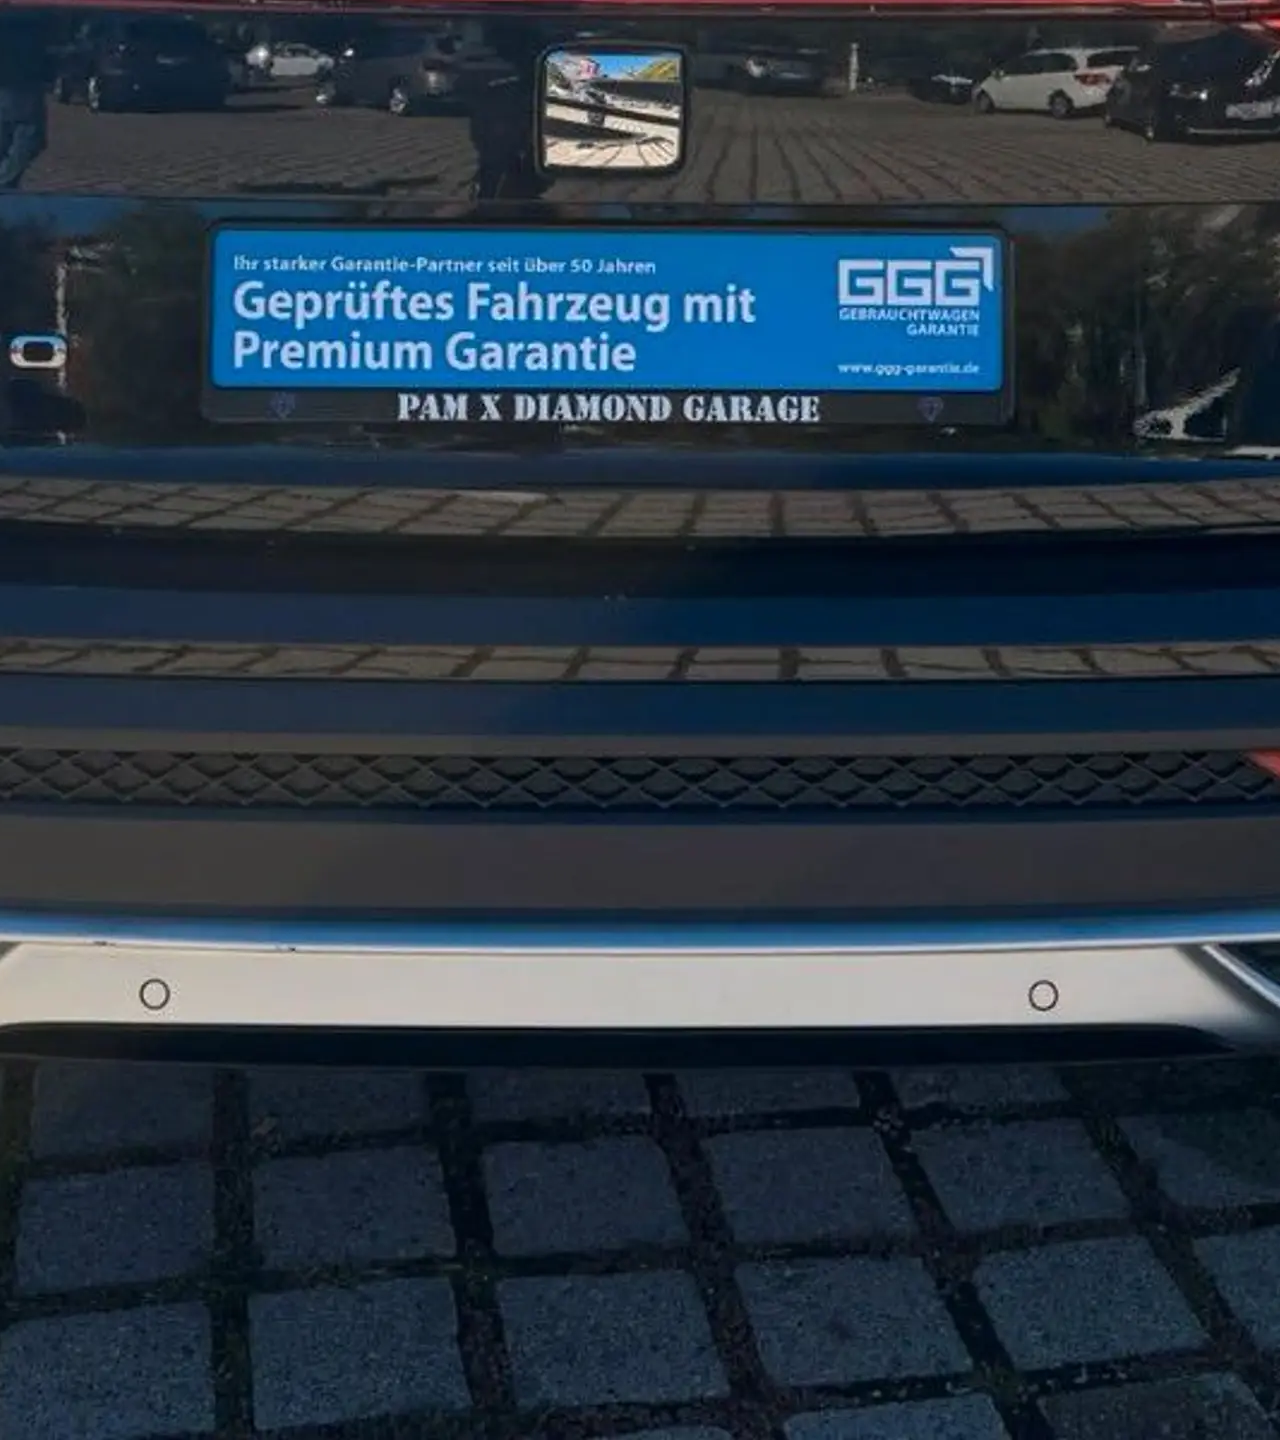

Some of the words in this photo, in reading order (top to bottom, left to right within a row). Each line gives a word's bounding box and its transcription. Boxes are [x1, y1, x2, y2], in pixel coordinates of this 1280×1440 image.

[234, 255, 257, 270] Ihr
[264, 255, 325, 271] starker
[331, 256, 482, 273] Garantie-Partner
[488, 257, 519, 273] seit
[524, 257, 565, 273] über
[570, 259, 592, 273] 50
[597, 258, 656, 275] Jahren
[838, 259, 980, 306] GGG
[233, 280, 454, 330] Geprüftes
[468, 281, 670, 332] Fahrzeug
[683, 283, 756, 323] mit
[838, 307, 980, 321] GEBRAUCHTWAGEN
[906, 323, 980, 337] GARANTIE
[234, 330, 432, 370] Premium
[445, 331, 636, 372] Garantie
[837, 362, 980, 376] www.ggg-garantie.de
[397, 392, 469, 421] PAM
[480, 392, 502, 421] X
[514, 393, 672, 422] DIAMOND
[683, 393, 820, 422] GARAGE
